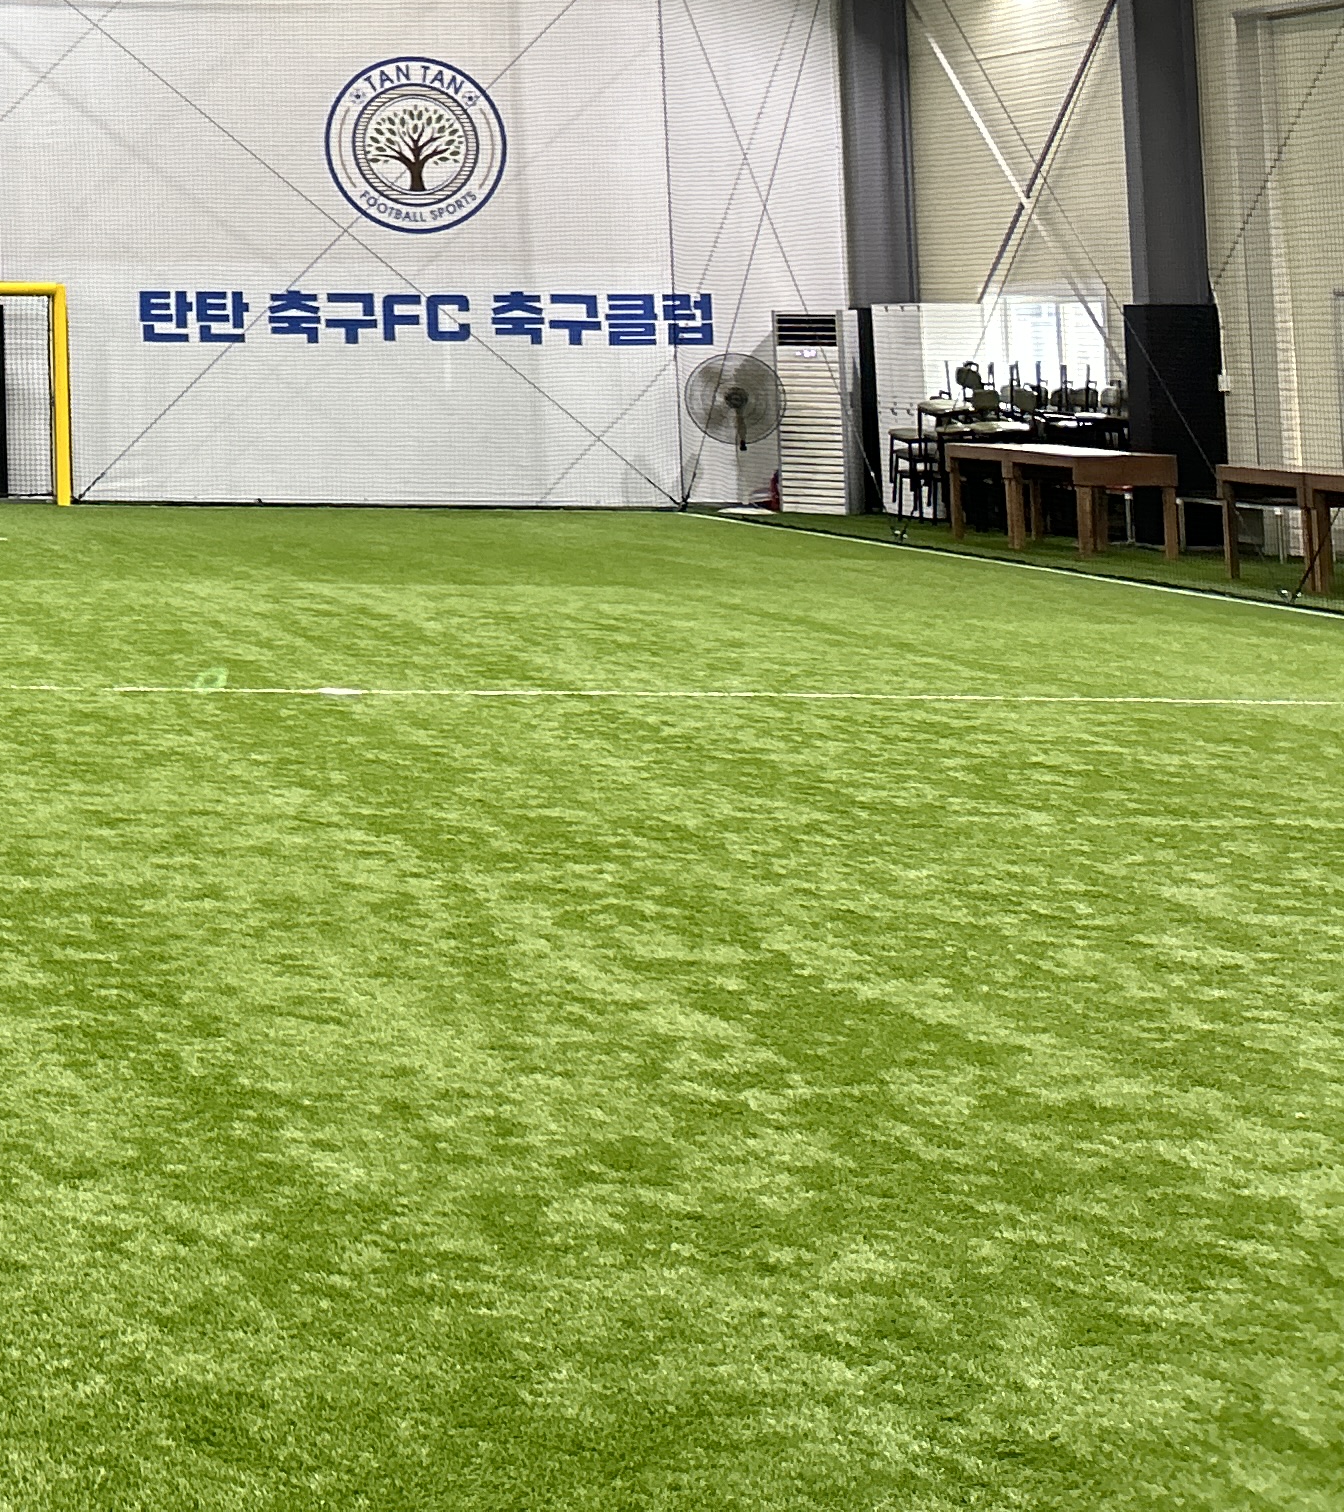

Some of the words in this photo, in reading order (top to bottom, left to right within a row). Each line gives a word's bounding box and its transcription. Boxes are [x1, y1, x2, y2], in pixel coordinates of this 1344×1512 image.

[364, 64, 411, 92] TAN
[421, 65, 465, 95] TAN
[360, 190, 426, 223] FOOTBALL
[430, 190, 477, 221] SPORTS
[139, 290, 249, 343] 탄탄
[268, 290, 471, 345] 축구FC
[490, 291, 714, 346] 축구클럽
